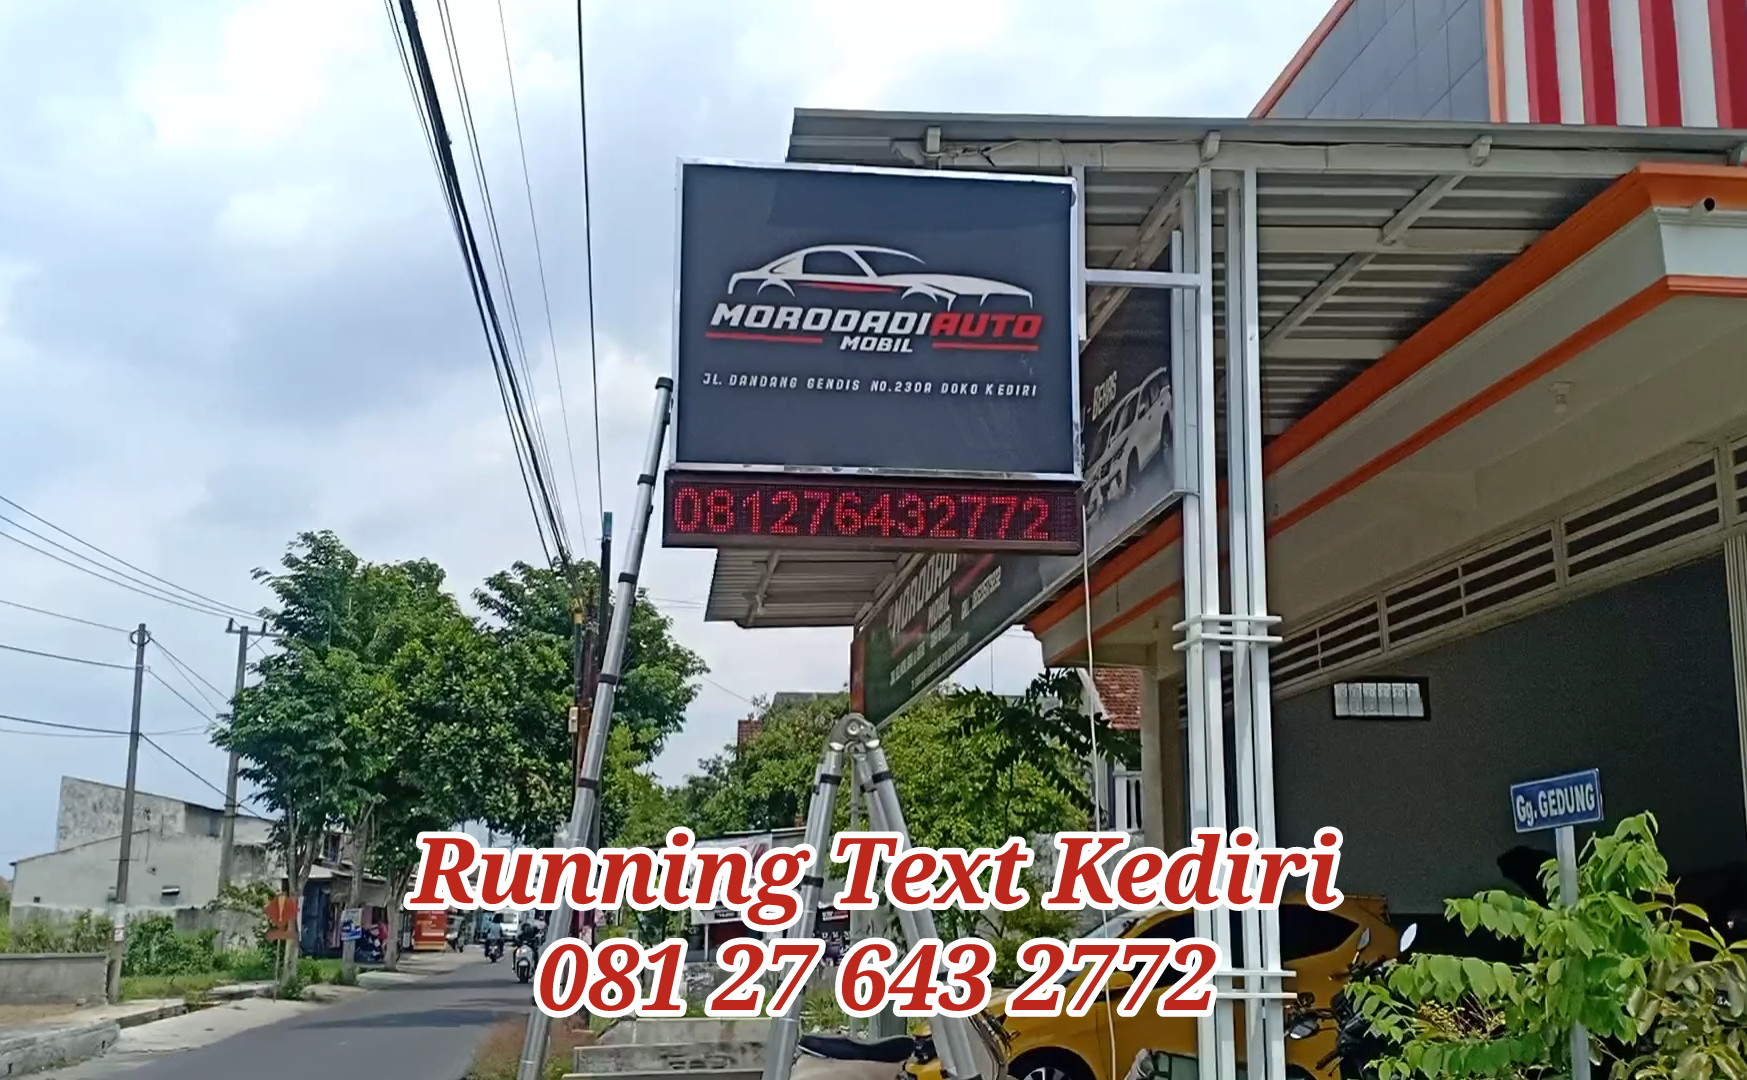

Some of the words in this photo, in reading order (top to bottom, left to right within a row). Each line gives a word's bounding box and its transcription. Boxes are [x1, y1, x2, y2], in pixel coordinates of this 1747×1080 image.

[840, 336, 914, 353] MOBIL
[702, 372, 723, 386] JL.
[728, 374, 798, 389] DANDANG
[807, 377, 860, 392] GENDIS
[941, 382, 979, 395] DOKO
[985, 383, 1038, 397] KEDIRI
[673, 486, 1050, 540] 081276432772
[1516, 794, 1538, 827] Gg.
[1538, 783, 1596, 818] GEDUNG
